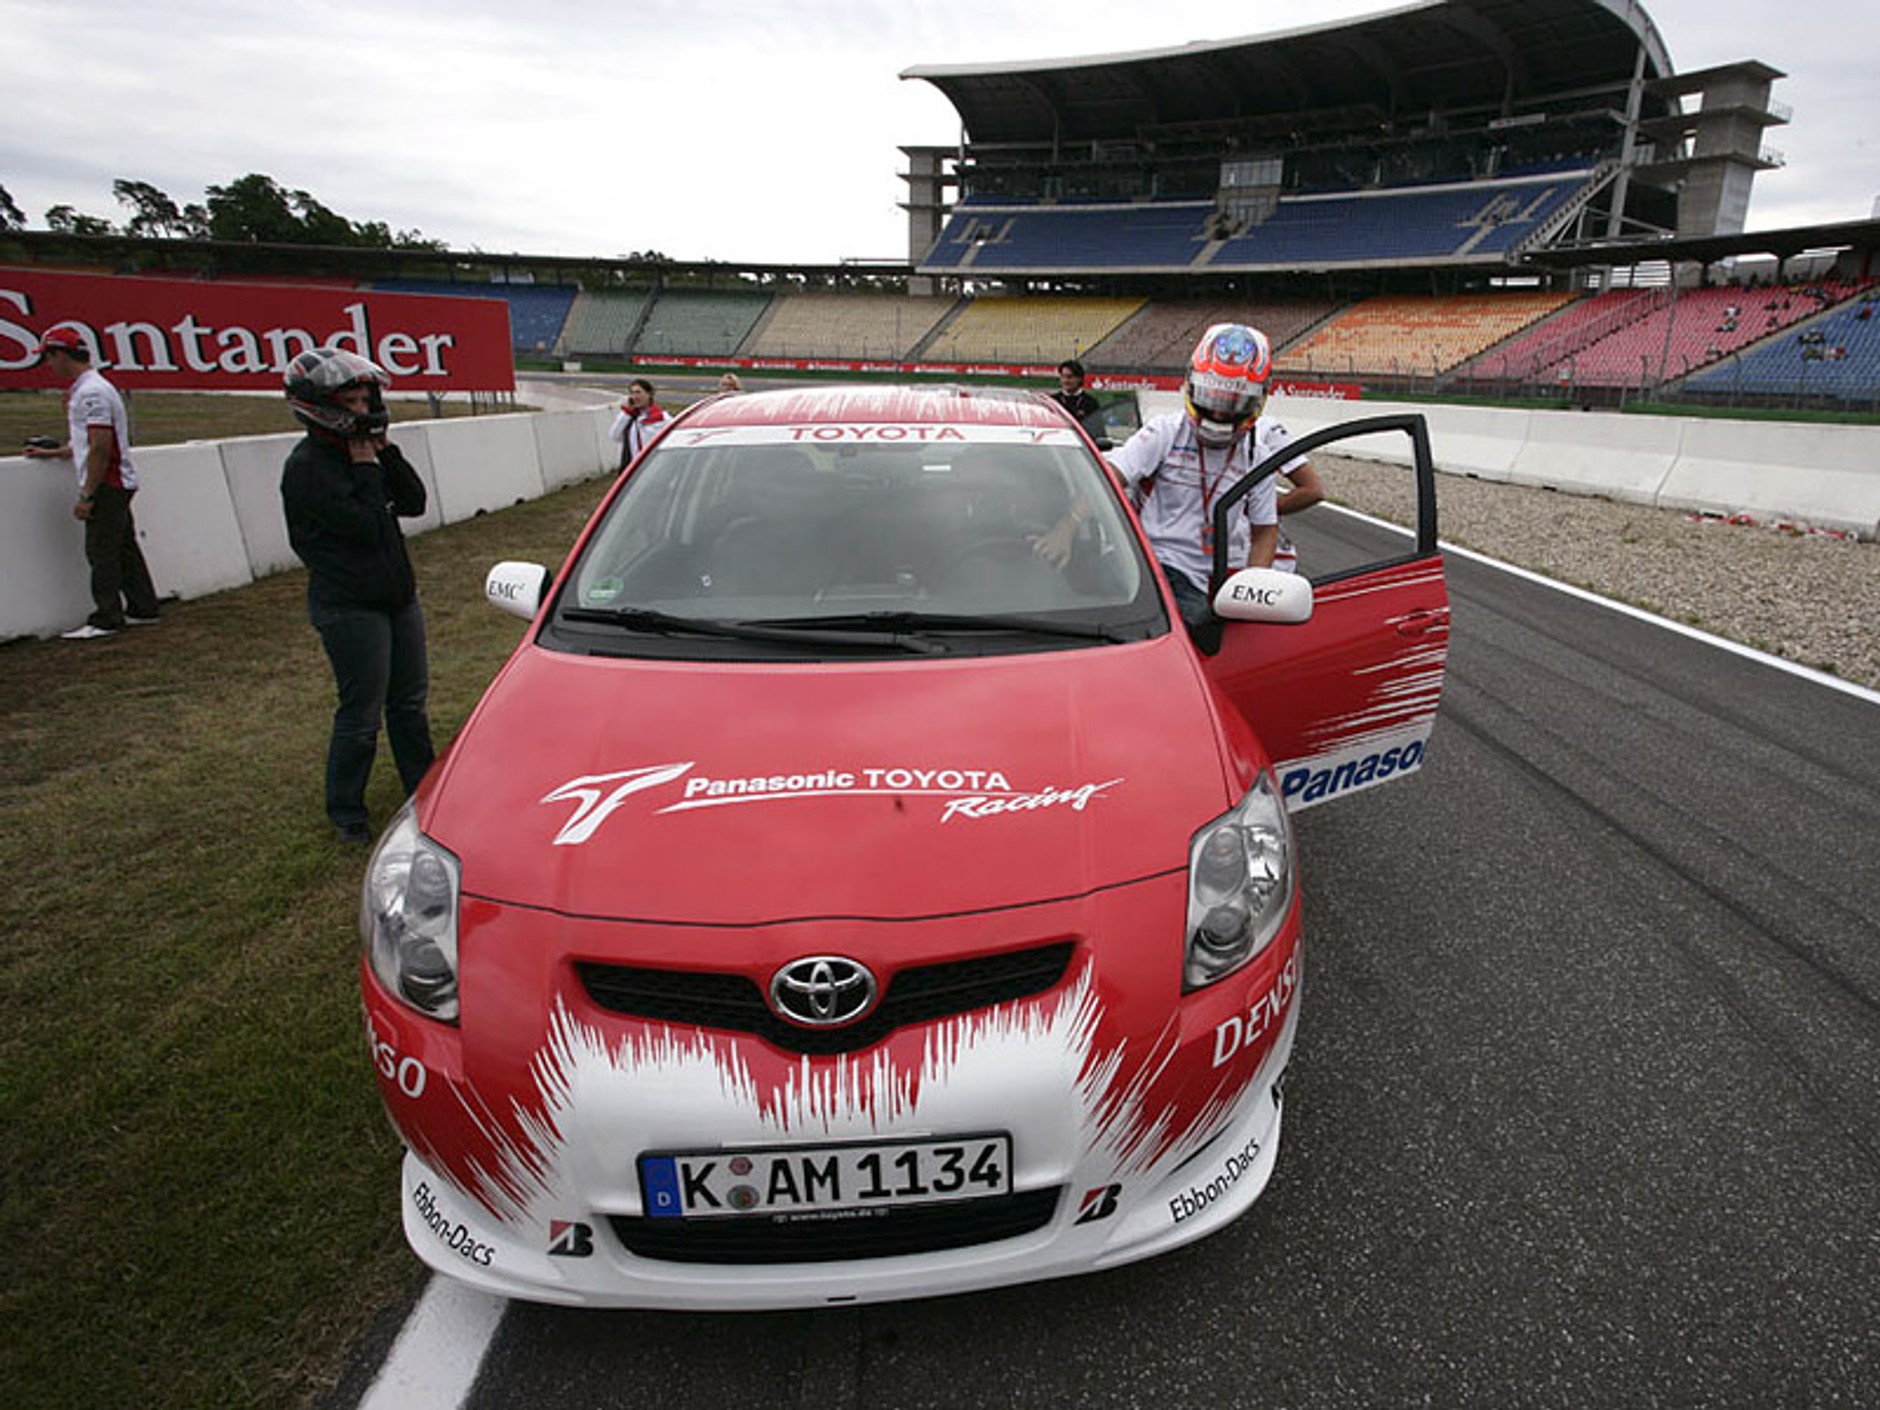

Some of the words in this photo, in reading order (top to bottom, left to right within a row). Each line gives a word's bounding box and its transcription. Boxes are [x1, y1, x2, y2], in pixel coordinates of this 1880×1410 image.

[0, 289, 454, 377] Santander
[789, 427, 966, 441] TOYOTA
[683, 769, 855, 798] Panasonic
[863, 768, 1011, 791] TOYOTA
[940, 778, 1125, 823] Racing
[1282, 740, 1425, 802] Panaso
[657, 1191, 672, 1207] D
[681, 1162, 721, 1209] K
[766, 1156, 841, 1205] AM
[856, 1144, 1001, 1199] 1134
[1168, 1138, 1262, 1224] Ebbon-Dacs
[412, 1181, 496, 1267] Ebbon-Dacs
